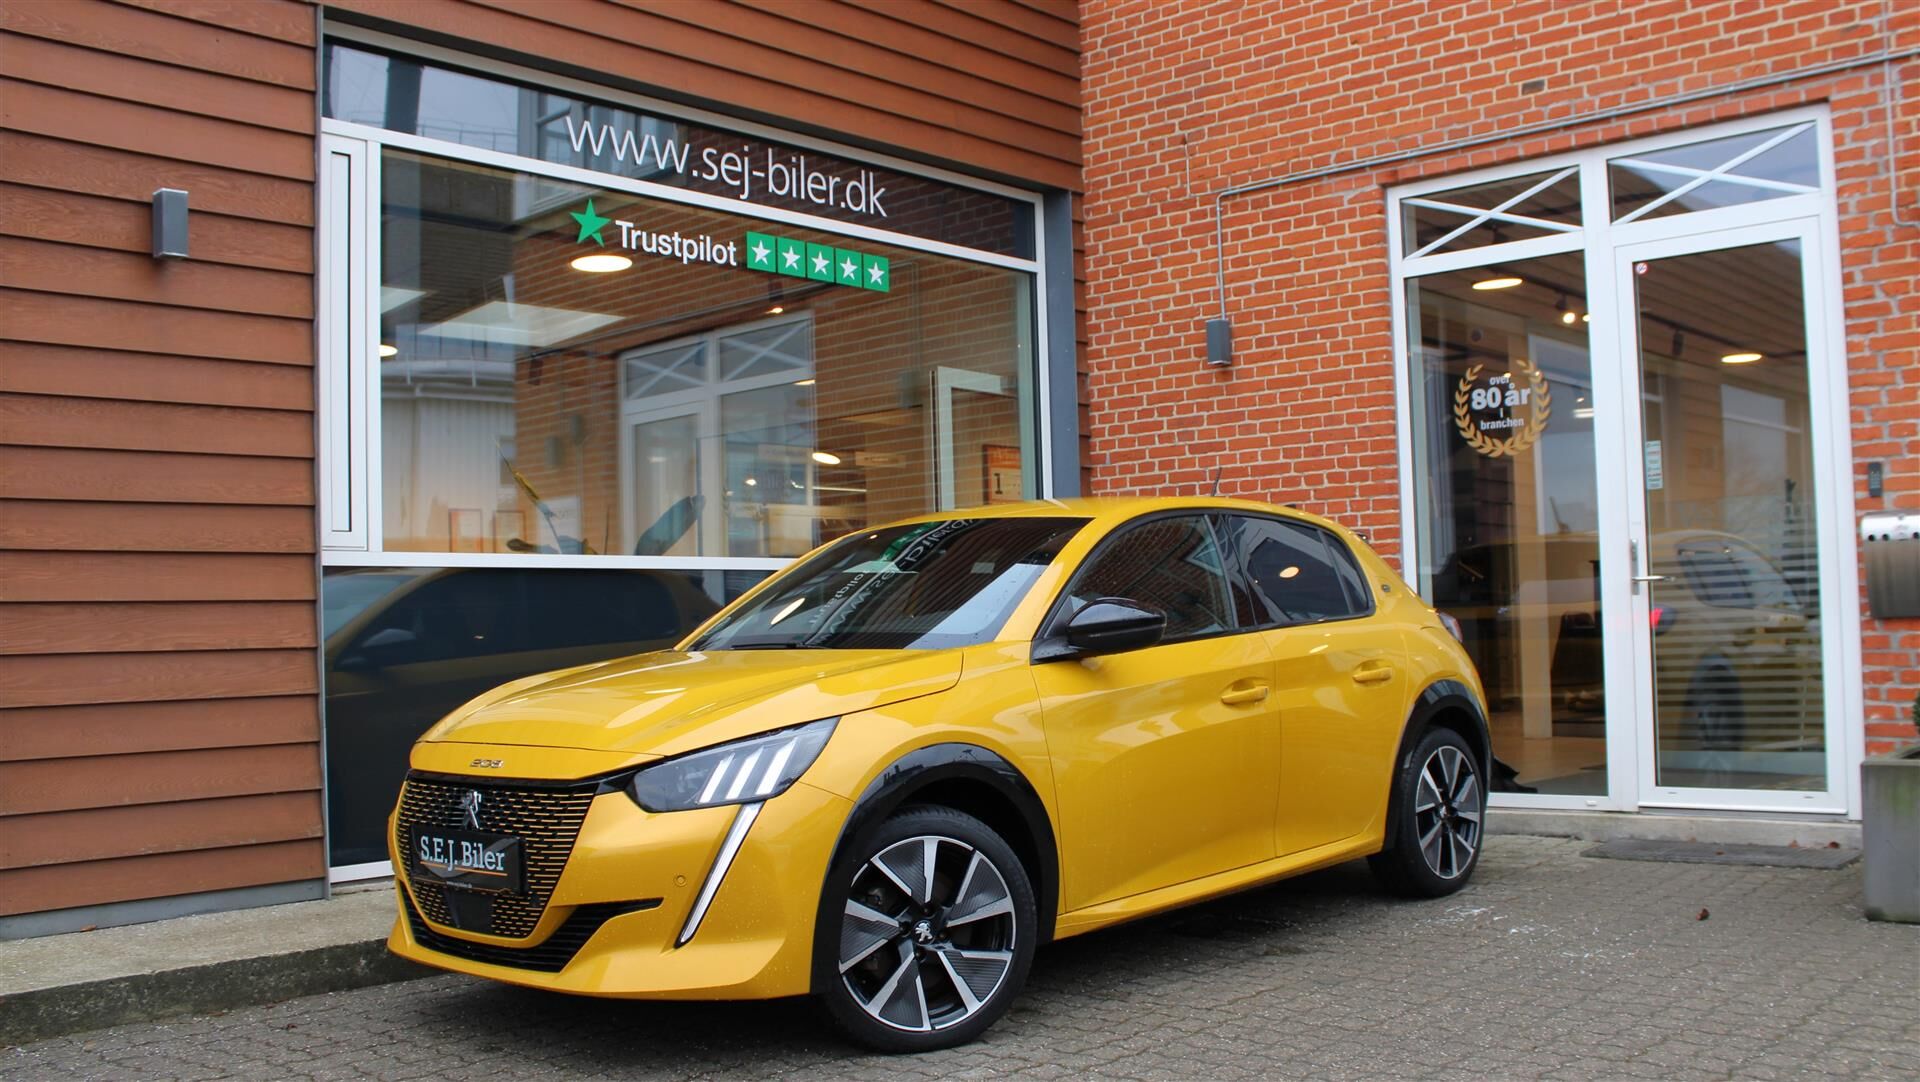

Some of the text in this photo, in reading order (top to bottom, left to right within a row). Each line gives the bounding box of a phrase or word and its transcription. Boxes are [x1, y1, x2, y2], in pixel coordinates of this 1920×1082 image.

[566, 115, 887, 217] www.sej-biler.dk
[615, 220, 737, 266] Trustpilot
[1471, 382, 1531, 410] 80 år
[1489, 375, 1511, 386] over
[1480, 418, 1524, 430] branchen
[420, 835, 505, 871] S.E.J. Biler
